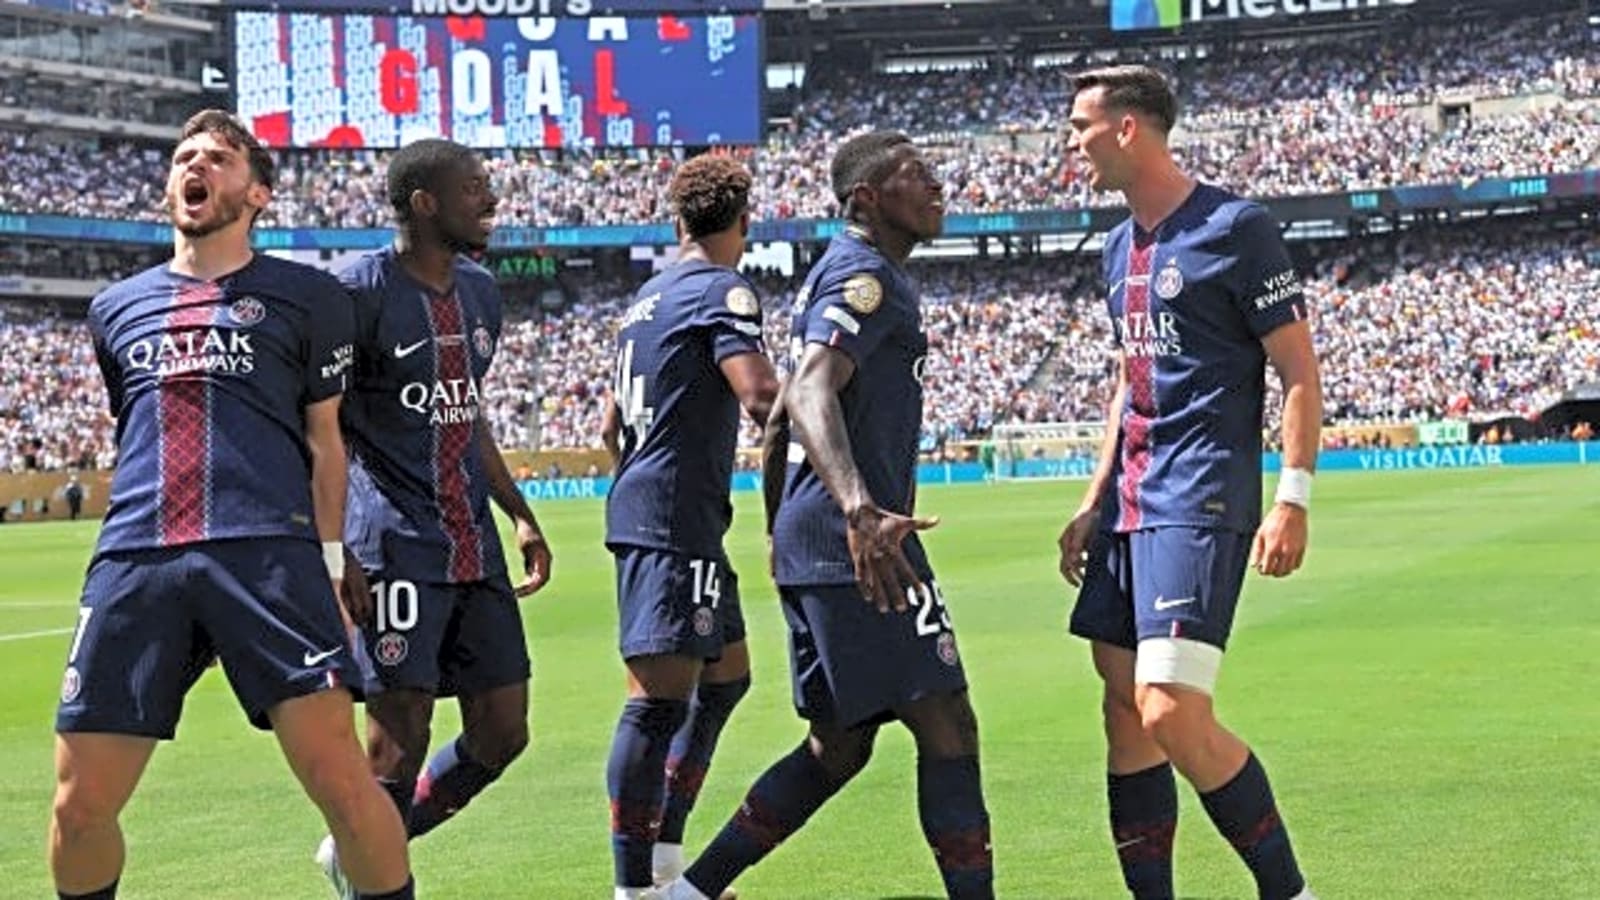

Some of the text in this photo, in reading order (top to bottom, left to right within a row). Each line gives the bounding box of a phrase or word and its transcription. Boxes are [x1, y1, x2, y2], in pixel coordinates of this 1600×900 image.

[412, 0, 593, 16] MOODYS
[380, 48, 628, 116] GOAL
[500, 257, 556, 276] ATAR
[1114, 312, 1180, 338] ATAR
[400, 377, 479, 413] QATA
[429, 406, 478, 424] AIRW
[689, 560, 720, 609] 14
[369, 580, 418, 633] 10
[70, 607, 93, 663] 7
